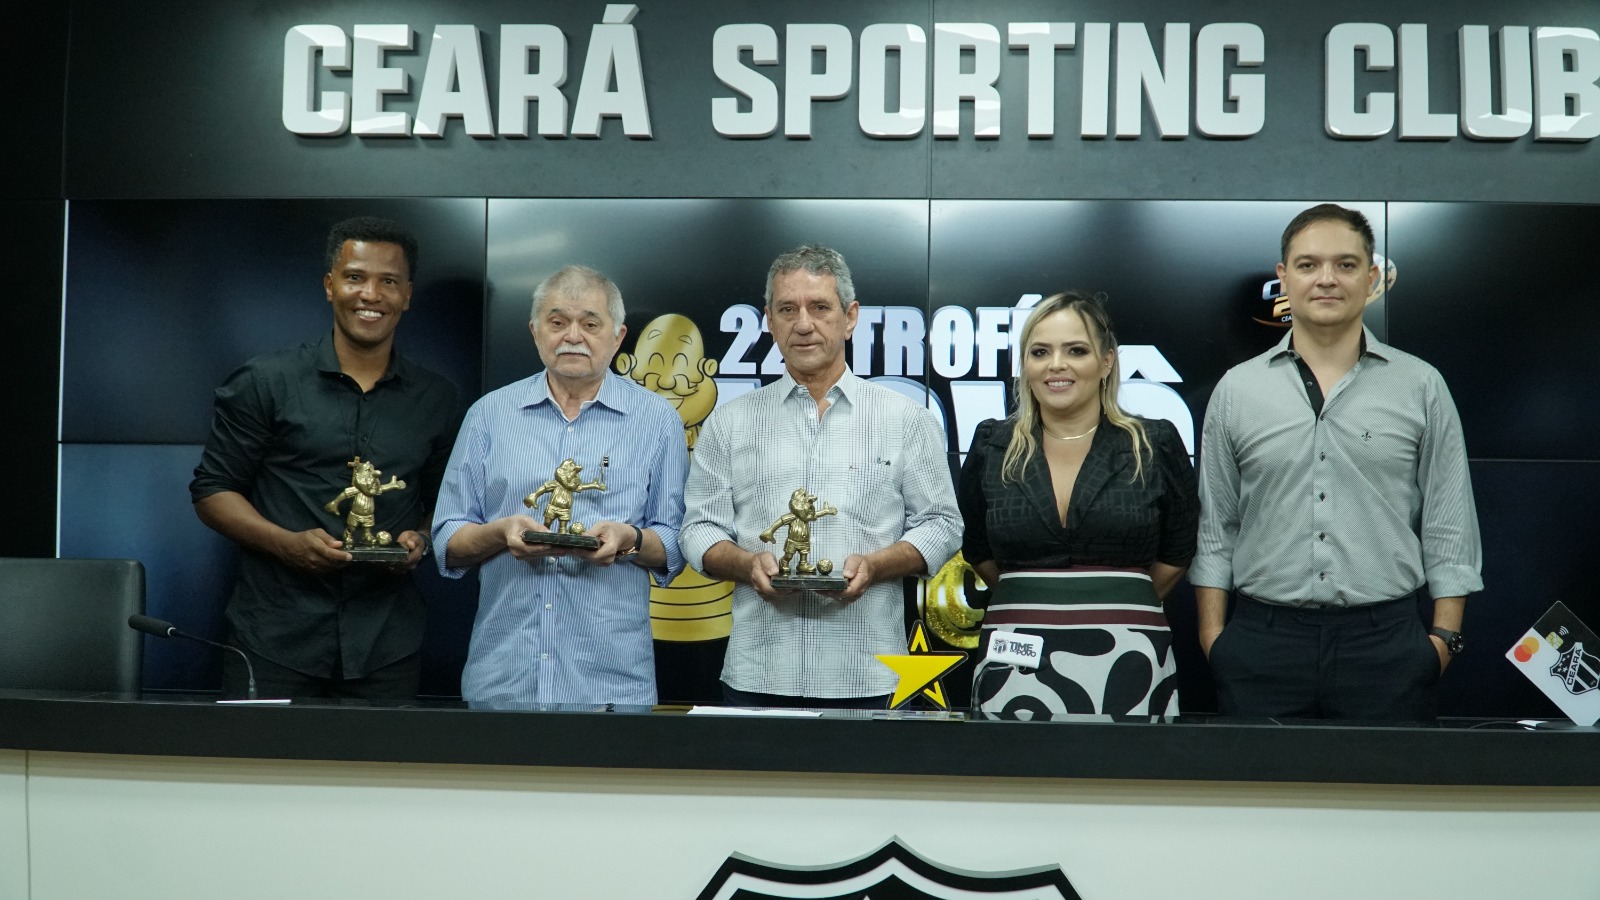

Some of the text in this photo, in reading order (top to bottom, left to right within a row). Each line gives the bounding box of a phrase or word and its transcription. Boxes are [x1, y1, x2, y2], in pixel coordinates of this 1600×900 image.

[282, 4, 1600, 141] CEARÁ SPORTING CLUB
[1010, 641, 1033, 651] TIME
